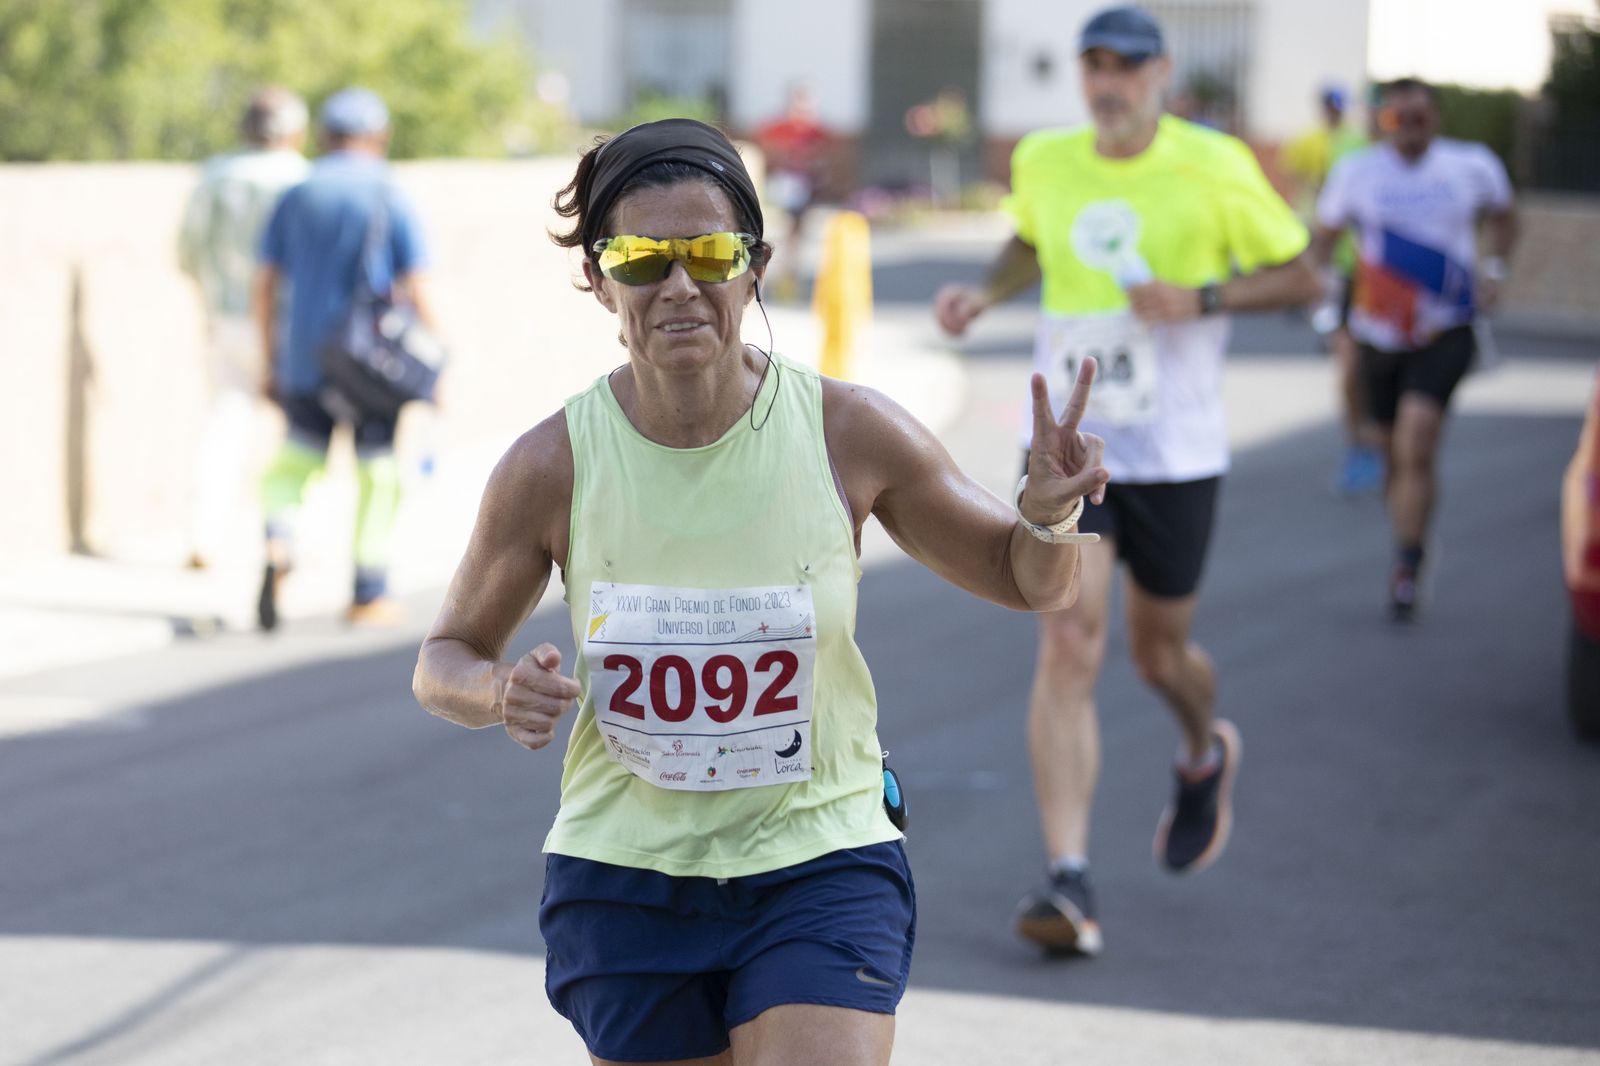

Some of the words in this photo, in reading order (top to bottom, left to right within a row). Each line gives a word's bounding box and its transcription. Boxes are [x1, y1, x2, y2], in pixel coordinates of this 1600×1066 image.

[615, 595, 642, 612] XXXVI
[764, 591, 792, 610] 2023
[603, 650, 799, 723] 2092
[774, 758, 803, 774] Lorca
